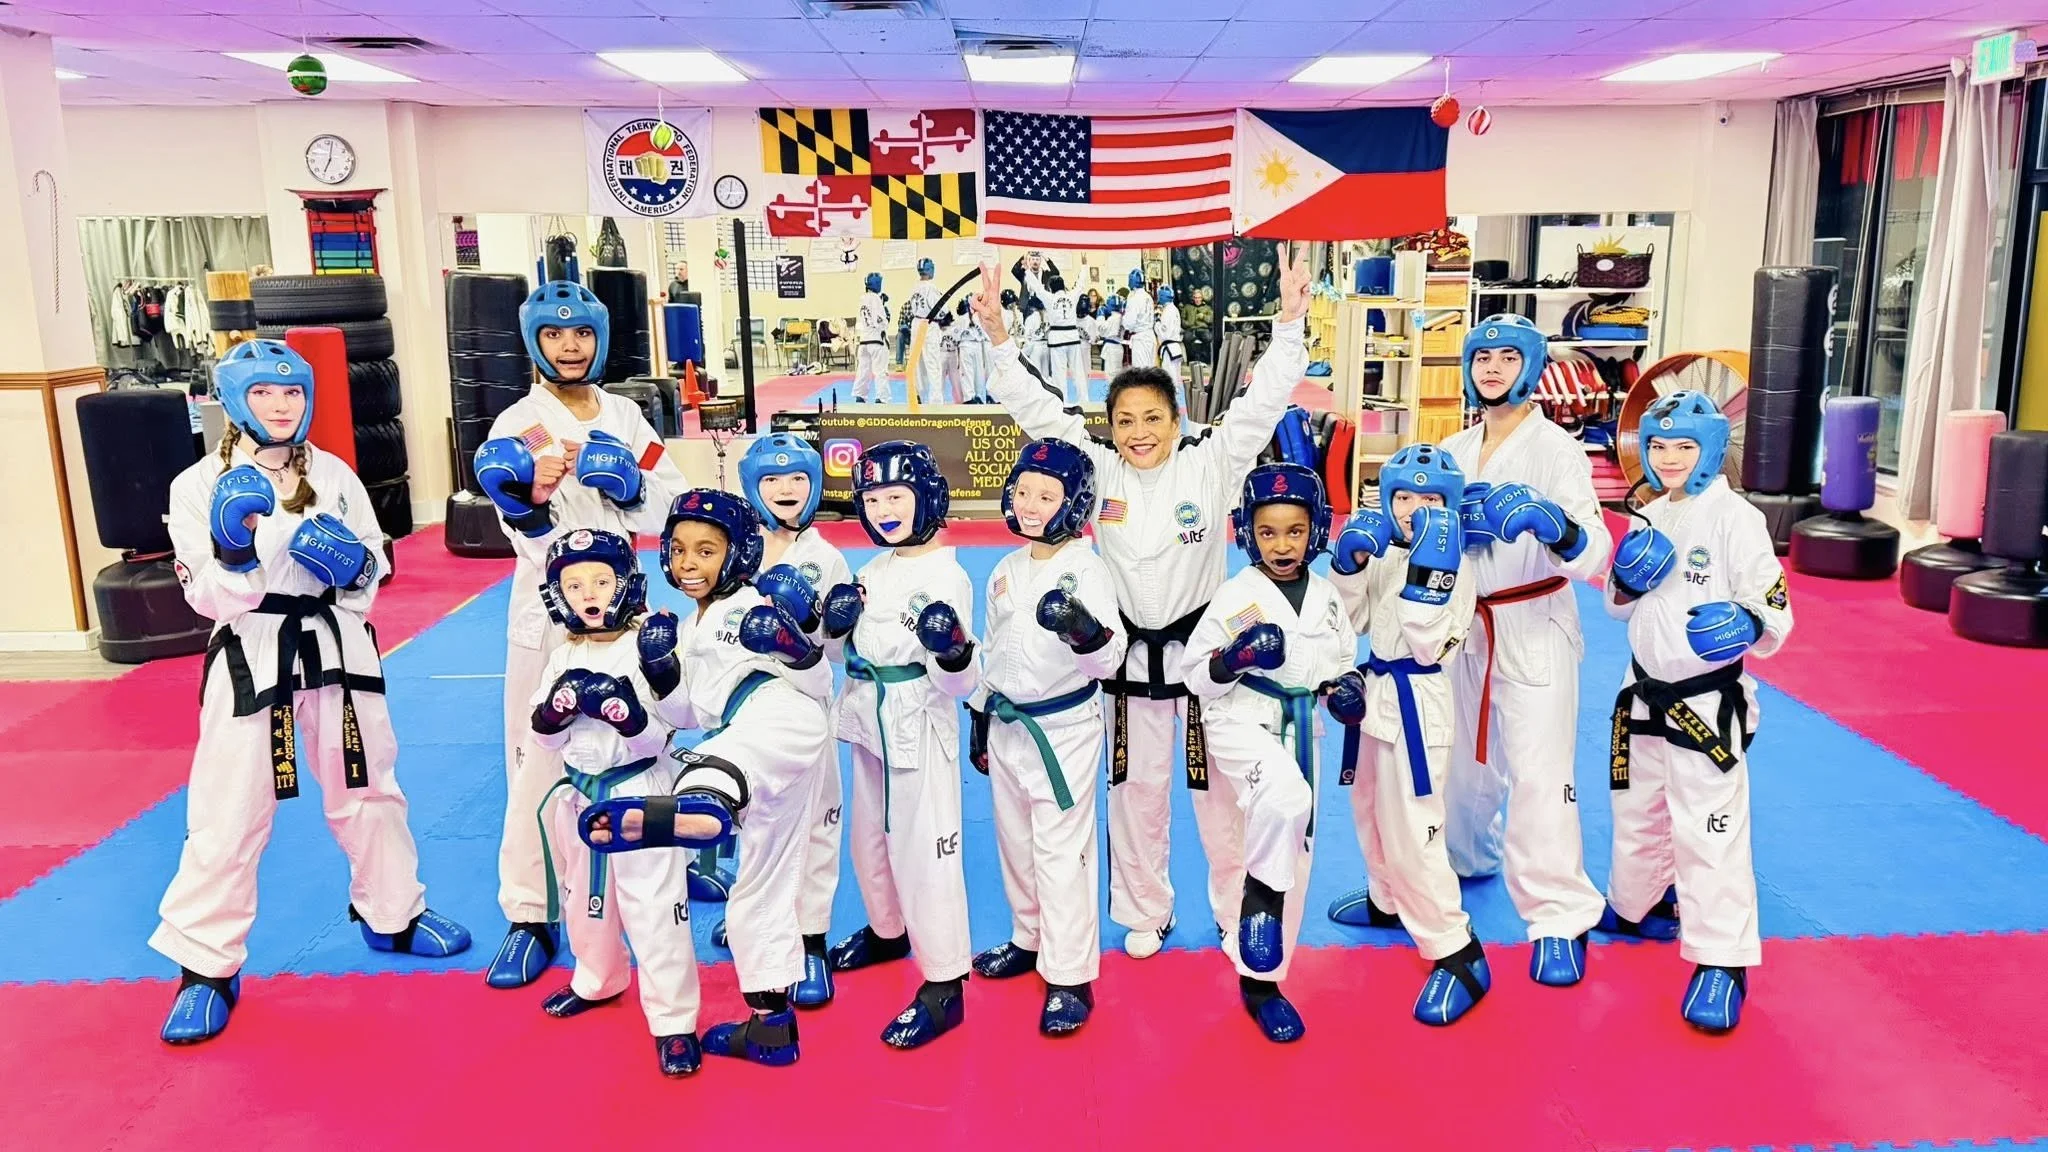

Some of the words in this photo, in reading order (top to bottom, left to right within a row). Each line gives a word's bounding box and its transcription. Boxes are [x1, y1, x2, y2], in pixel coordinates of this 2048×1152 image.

[606, 134, 627, 202] INTERNATIONAL
[626, 121, 683, 142] TAEKWO
[681, 143, 697, 201] FEDERATION
[633, 203, 675, 214] AMERICA
[857, 417, 992, 428] @GDDGoldenDragonDefense
[964, 425, 1022, 437] FOLLOW
[972, 438, 991, 449] US
[994, 438, 1016, 449] ON
[964, 451, 990, 462] ALL
[968, 463, 1013, 475] SOCIA
[823, 489, 853, 499] Instagr
[1495, 487, 1528, 511] MIGHT
[1436, 510, 1449, 553] TYFIST
[299, 531, 355, 568] MIGHTYFIST
[766, 573, 813, 604] MIGHTYFIS
[283, 705, 295, 760] TAEKWONDO
[1188, 767, 1207, 781] VI
[275, 773, 296, 790] ITF
